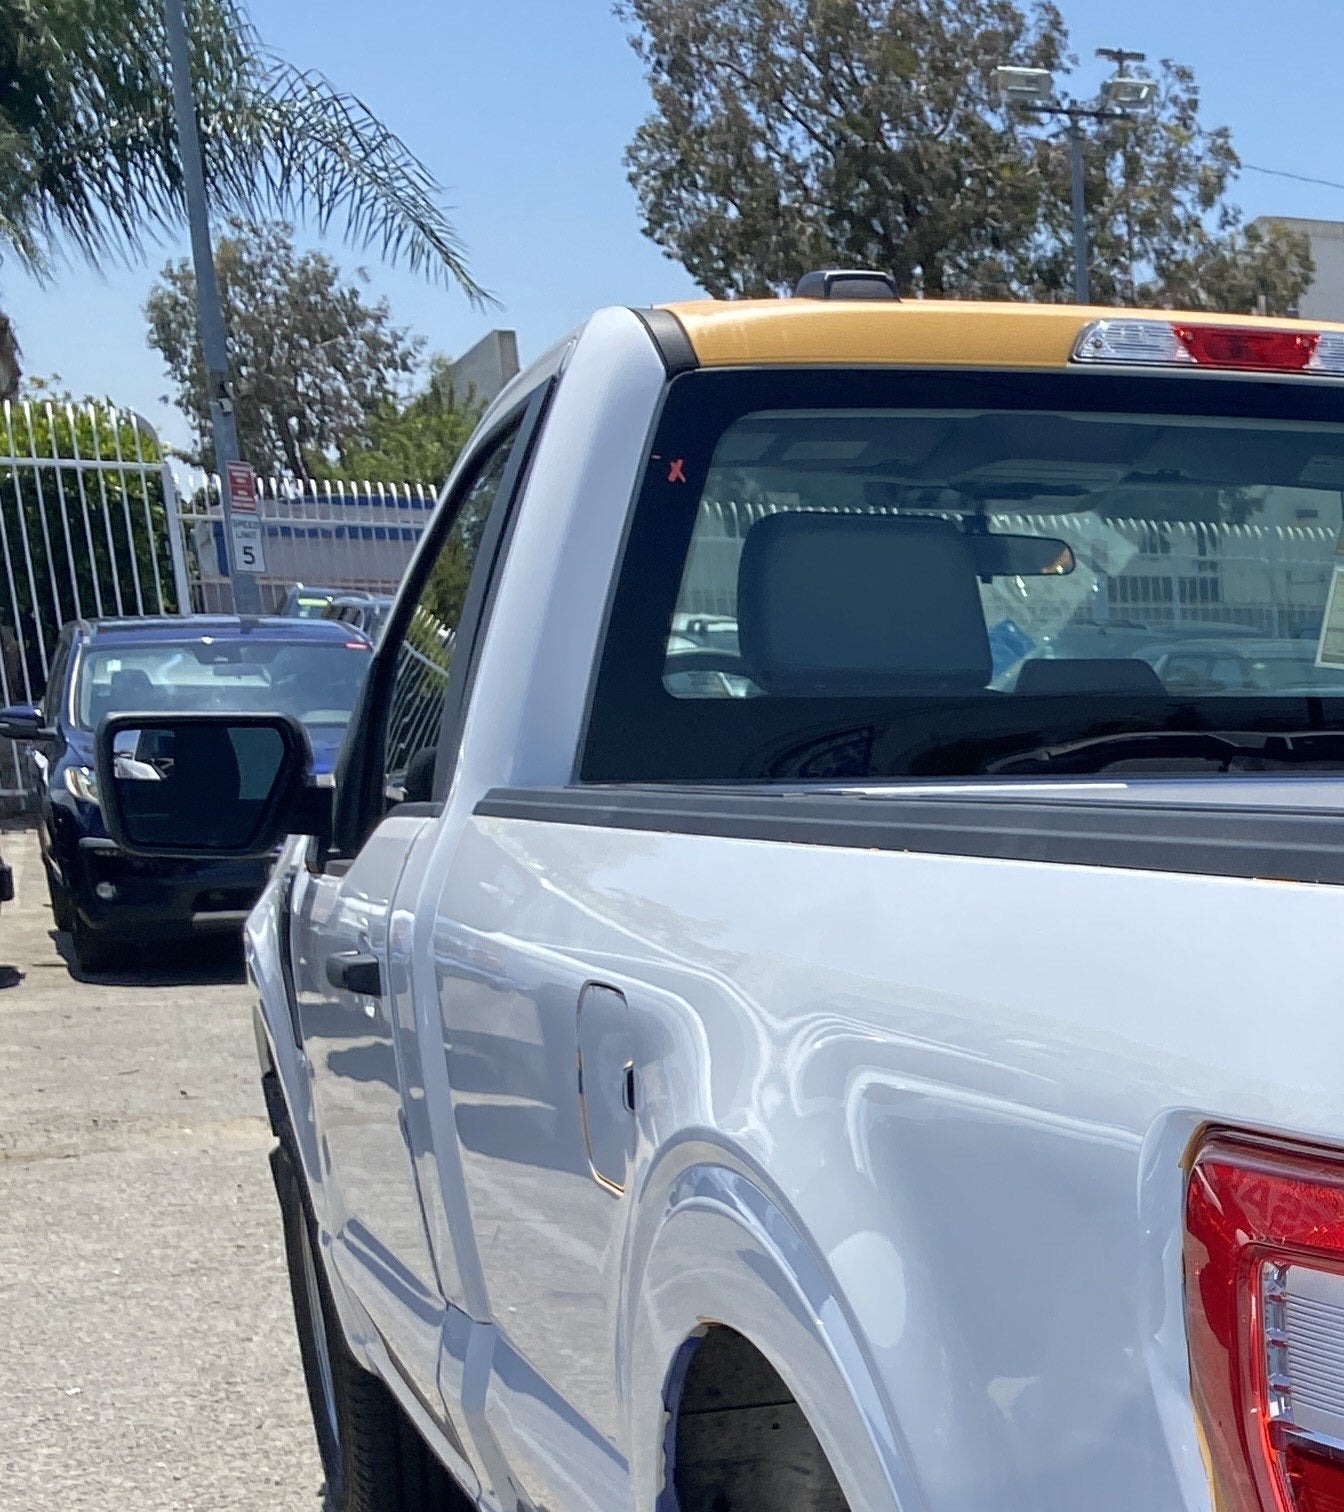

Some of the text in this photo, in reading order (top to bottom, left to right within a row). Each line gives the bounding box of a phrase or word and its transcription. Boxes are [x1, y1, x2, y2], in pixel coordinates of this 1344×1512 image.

[233, 520, 259, 529] SPEED
[236, 531, 257, 539] LIMIT
[243, 546, 255, 565] 5
